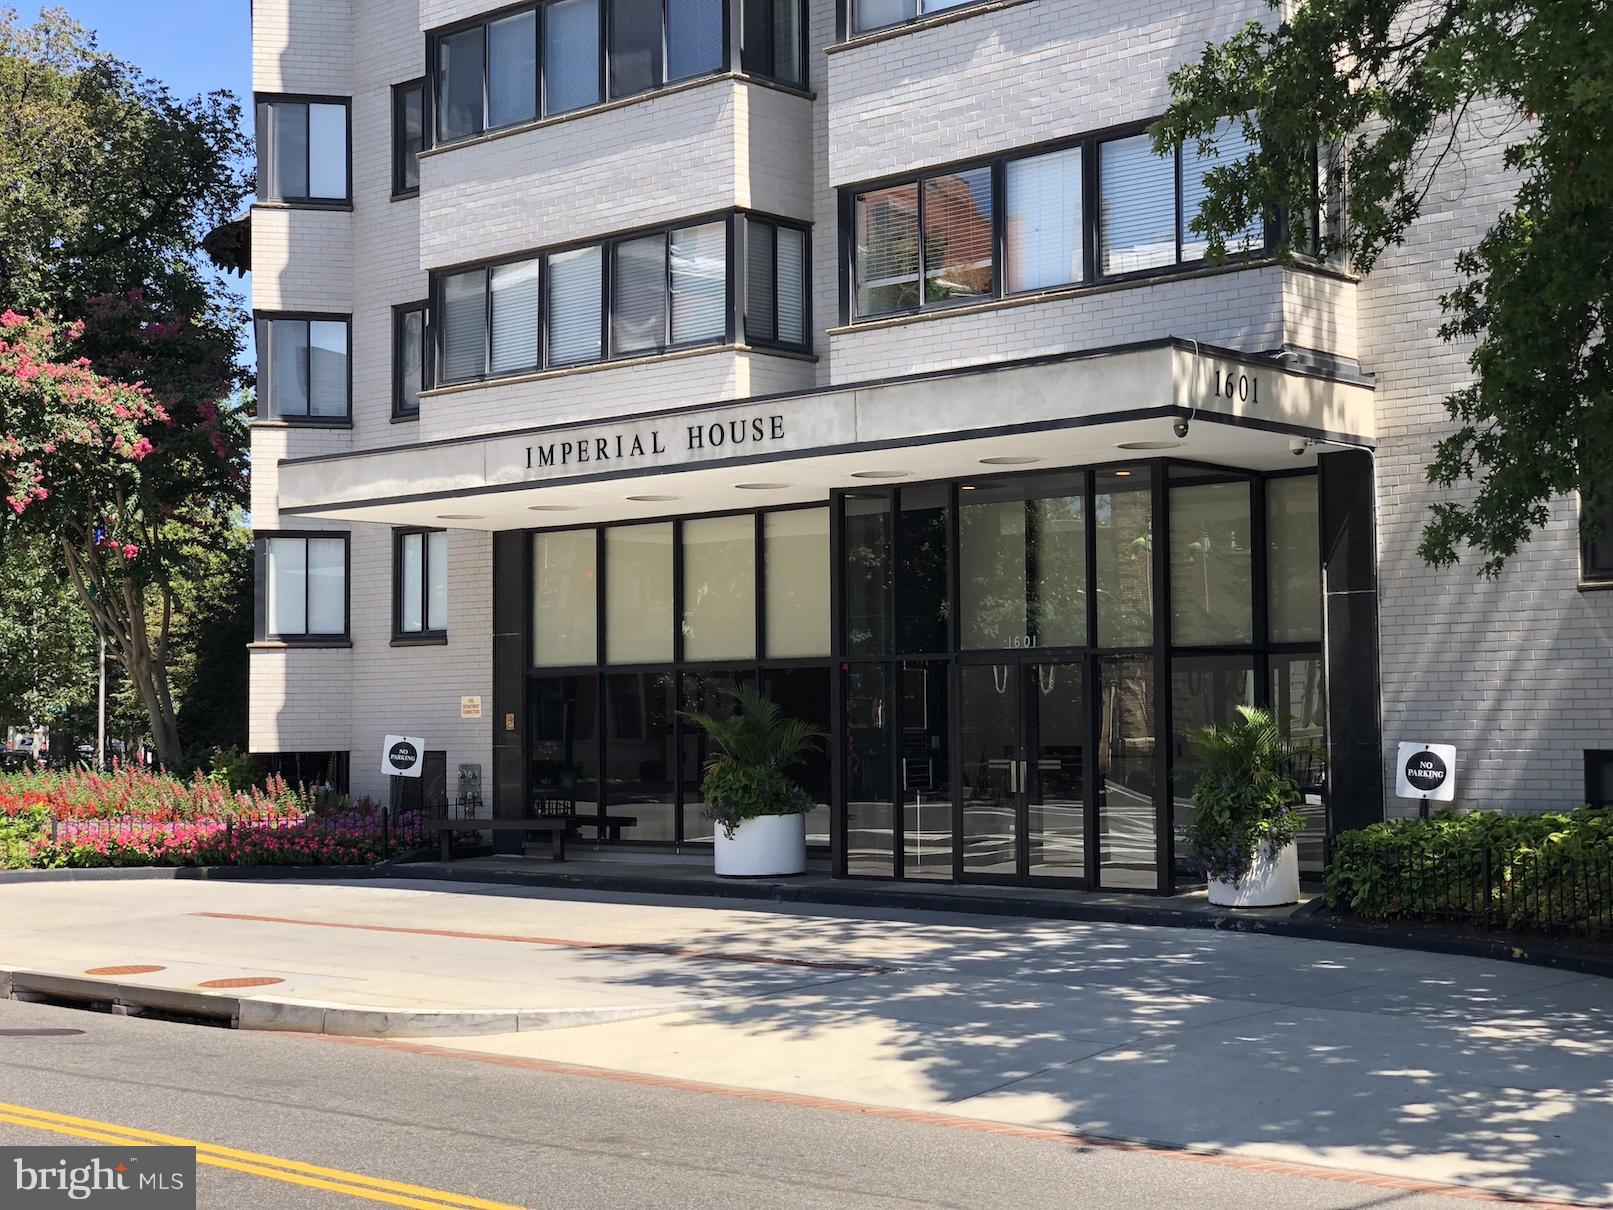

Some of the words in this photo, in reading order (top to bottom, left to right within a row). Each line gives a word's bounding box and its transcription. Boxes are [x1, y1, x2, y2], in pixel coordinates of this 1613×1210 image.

[1214, 370, 1258, 403] 1601
[526, 431, 666, 469] IMPERIAL
[686, 415, 785, 450] HOUSE
[1008, 635, 1036, 648] 1601
[390, 754, 416, 762] PARKING
[1419, 760, 1433, 770] NO
[1407, 768, 1444, 779] PARKING
